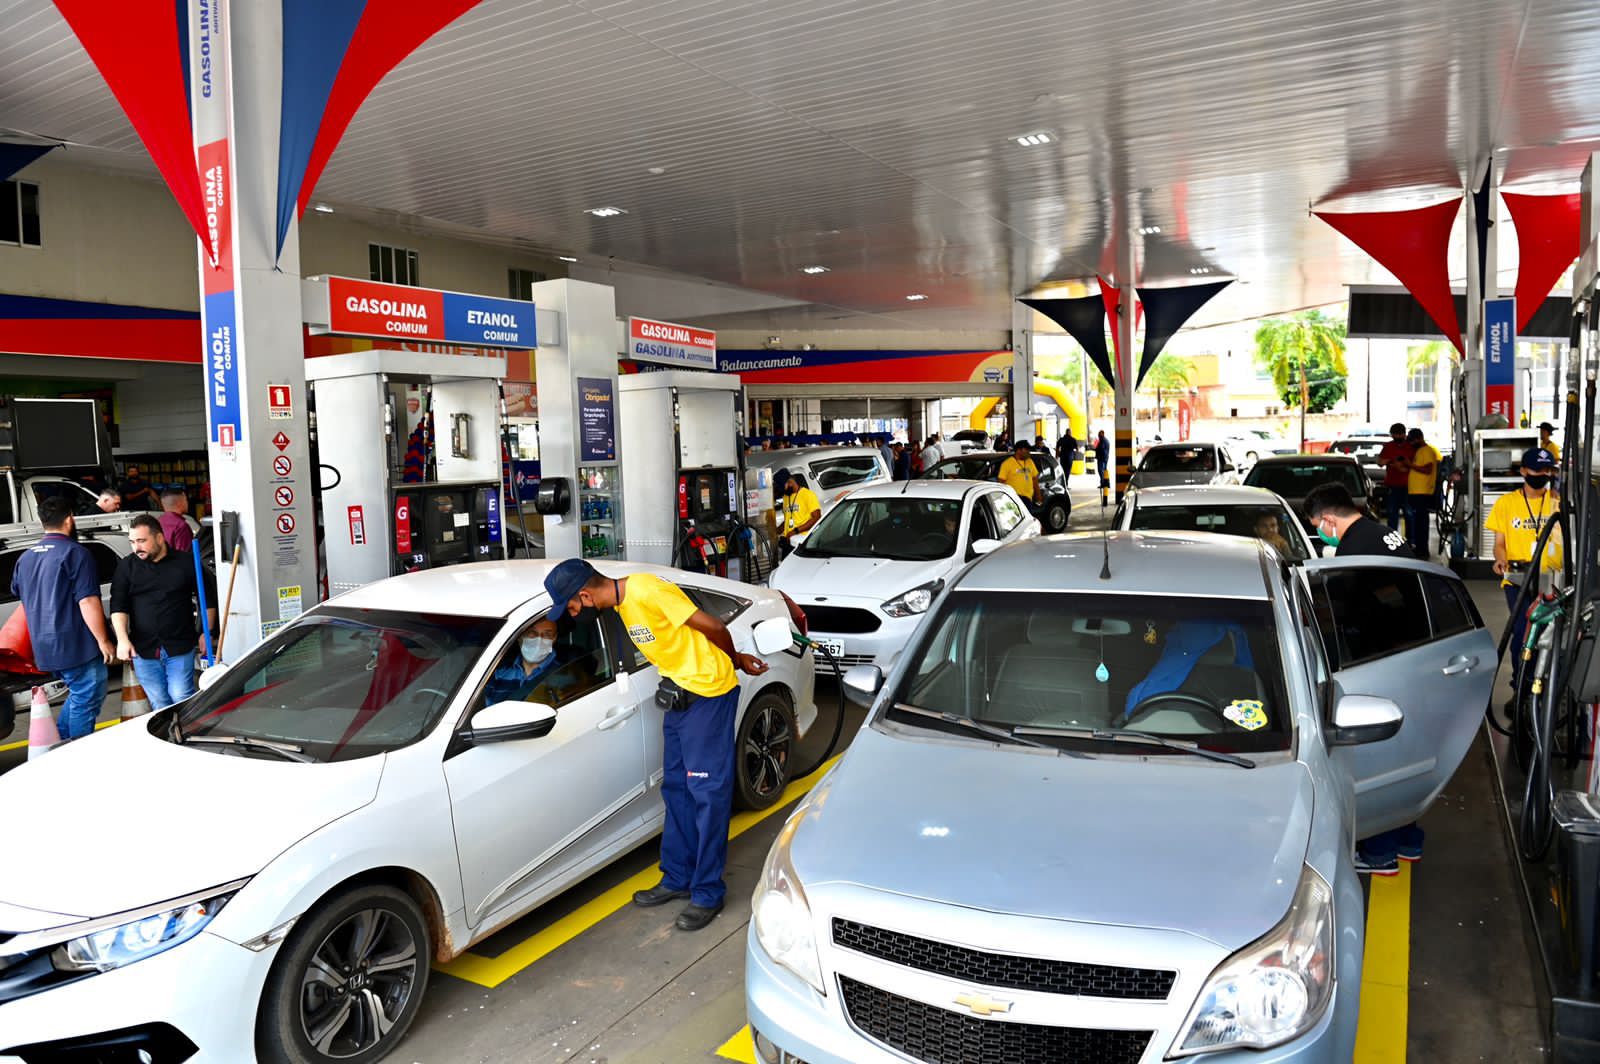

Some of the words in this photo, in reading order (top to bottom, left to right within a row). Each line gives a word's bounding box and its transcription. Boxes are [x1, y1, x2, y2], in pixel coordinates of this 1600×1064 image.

[200, 0, 211, 98] GASOLINA
[216, 165, 224, 207] COMUM
[346, 296, 427, 319] GASOLINA
[385, 321, 428, 334] COMUM
[467, 310, 518, 328] ETANOL
[483, 330, 519, 342] COMUM
[641, 323, 690, 343] GASOLINA
[223, 326, 232, 370] COMUM
[635, 342, 686, 359] GASOLINA
[1491, 322, 1500, 363] ETANOL
[212, 327, 226, 407] ETANOL
[720, 355, 803, 372] Balanceamento
[398, 506, 408, 520] G
[489, 499, 496, 511] E
[480, 545, 489, 554] 34
[413, 554, 424, 563] 33
